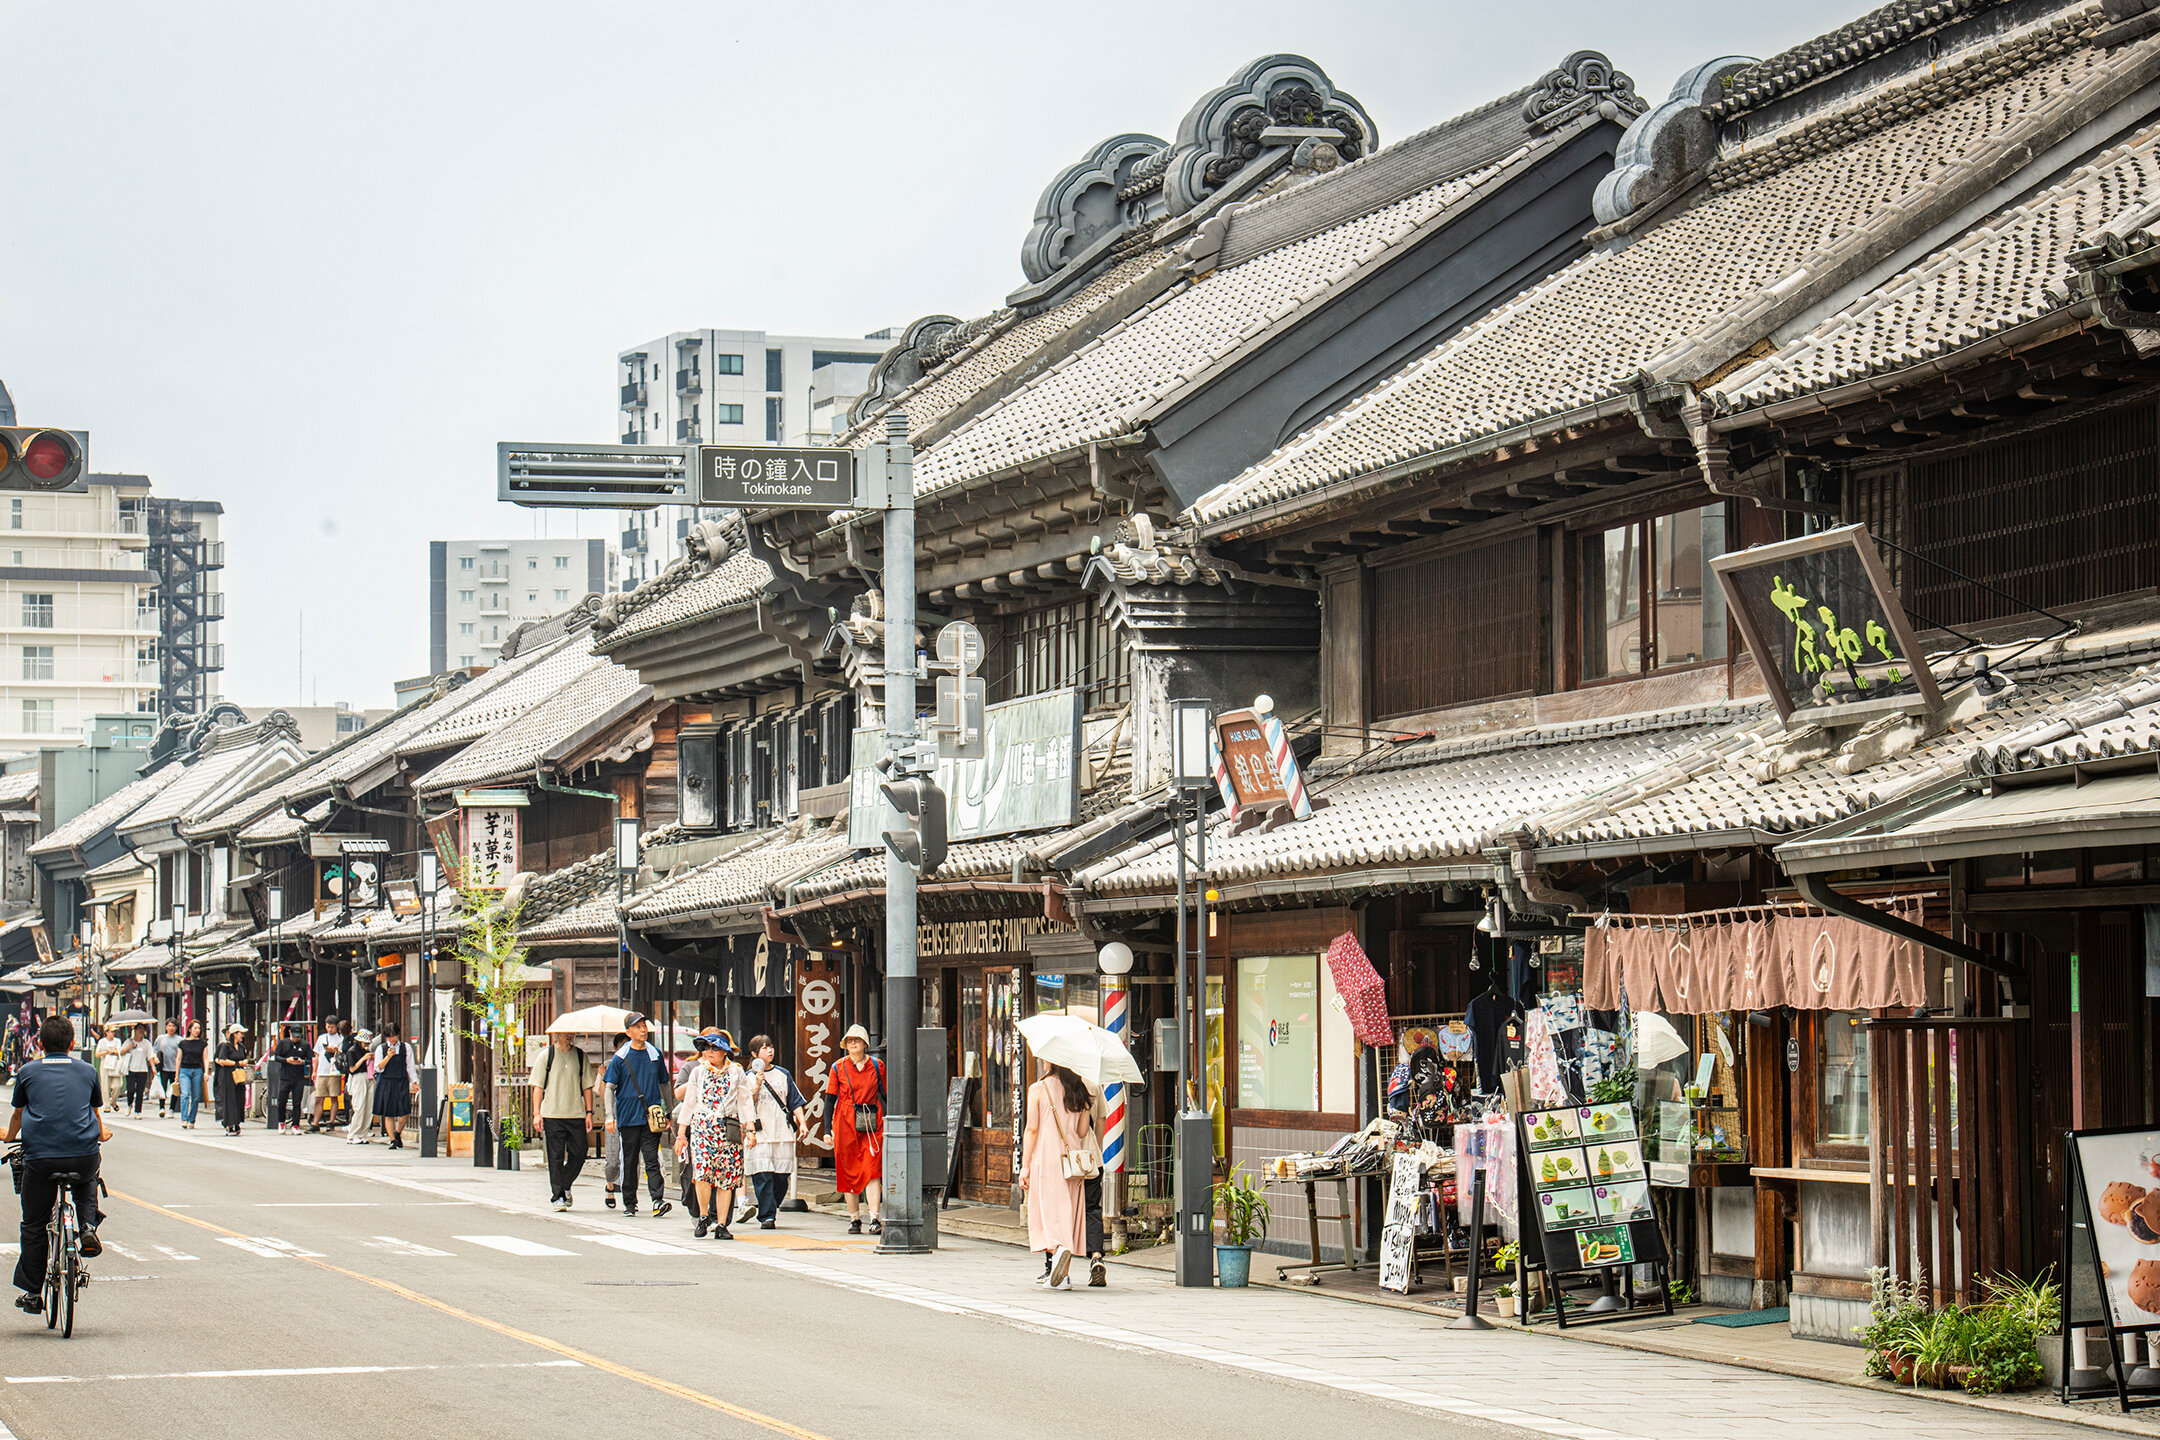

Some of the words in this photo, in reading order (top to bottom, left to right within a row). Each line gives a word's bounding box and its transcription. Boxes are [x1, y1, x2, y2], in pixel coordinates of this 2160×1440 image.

[714, 455, 838, 482] 時の鐘入口
[741, 482, 812, 495] Tokinokane
[1229, 731, 1243, 742] HAIR
[1243, 728, 1262, 741] SALON
[484, 811, 501, 885] 芋菓子
[503, 813, 514, 864] 川越名物
[917, 922, 943, 957] REENS
[944, 918, 1002, 955] EMBROIDERIES
